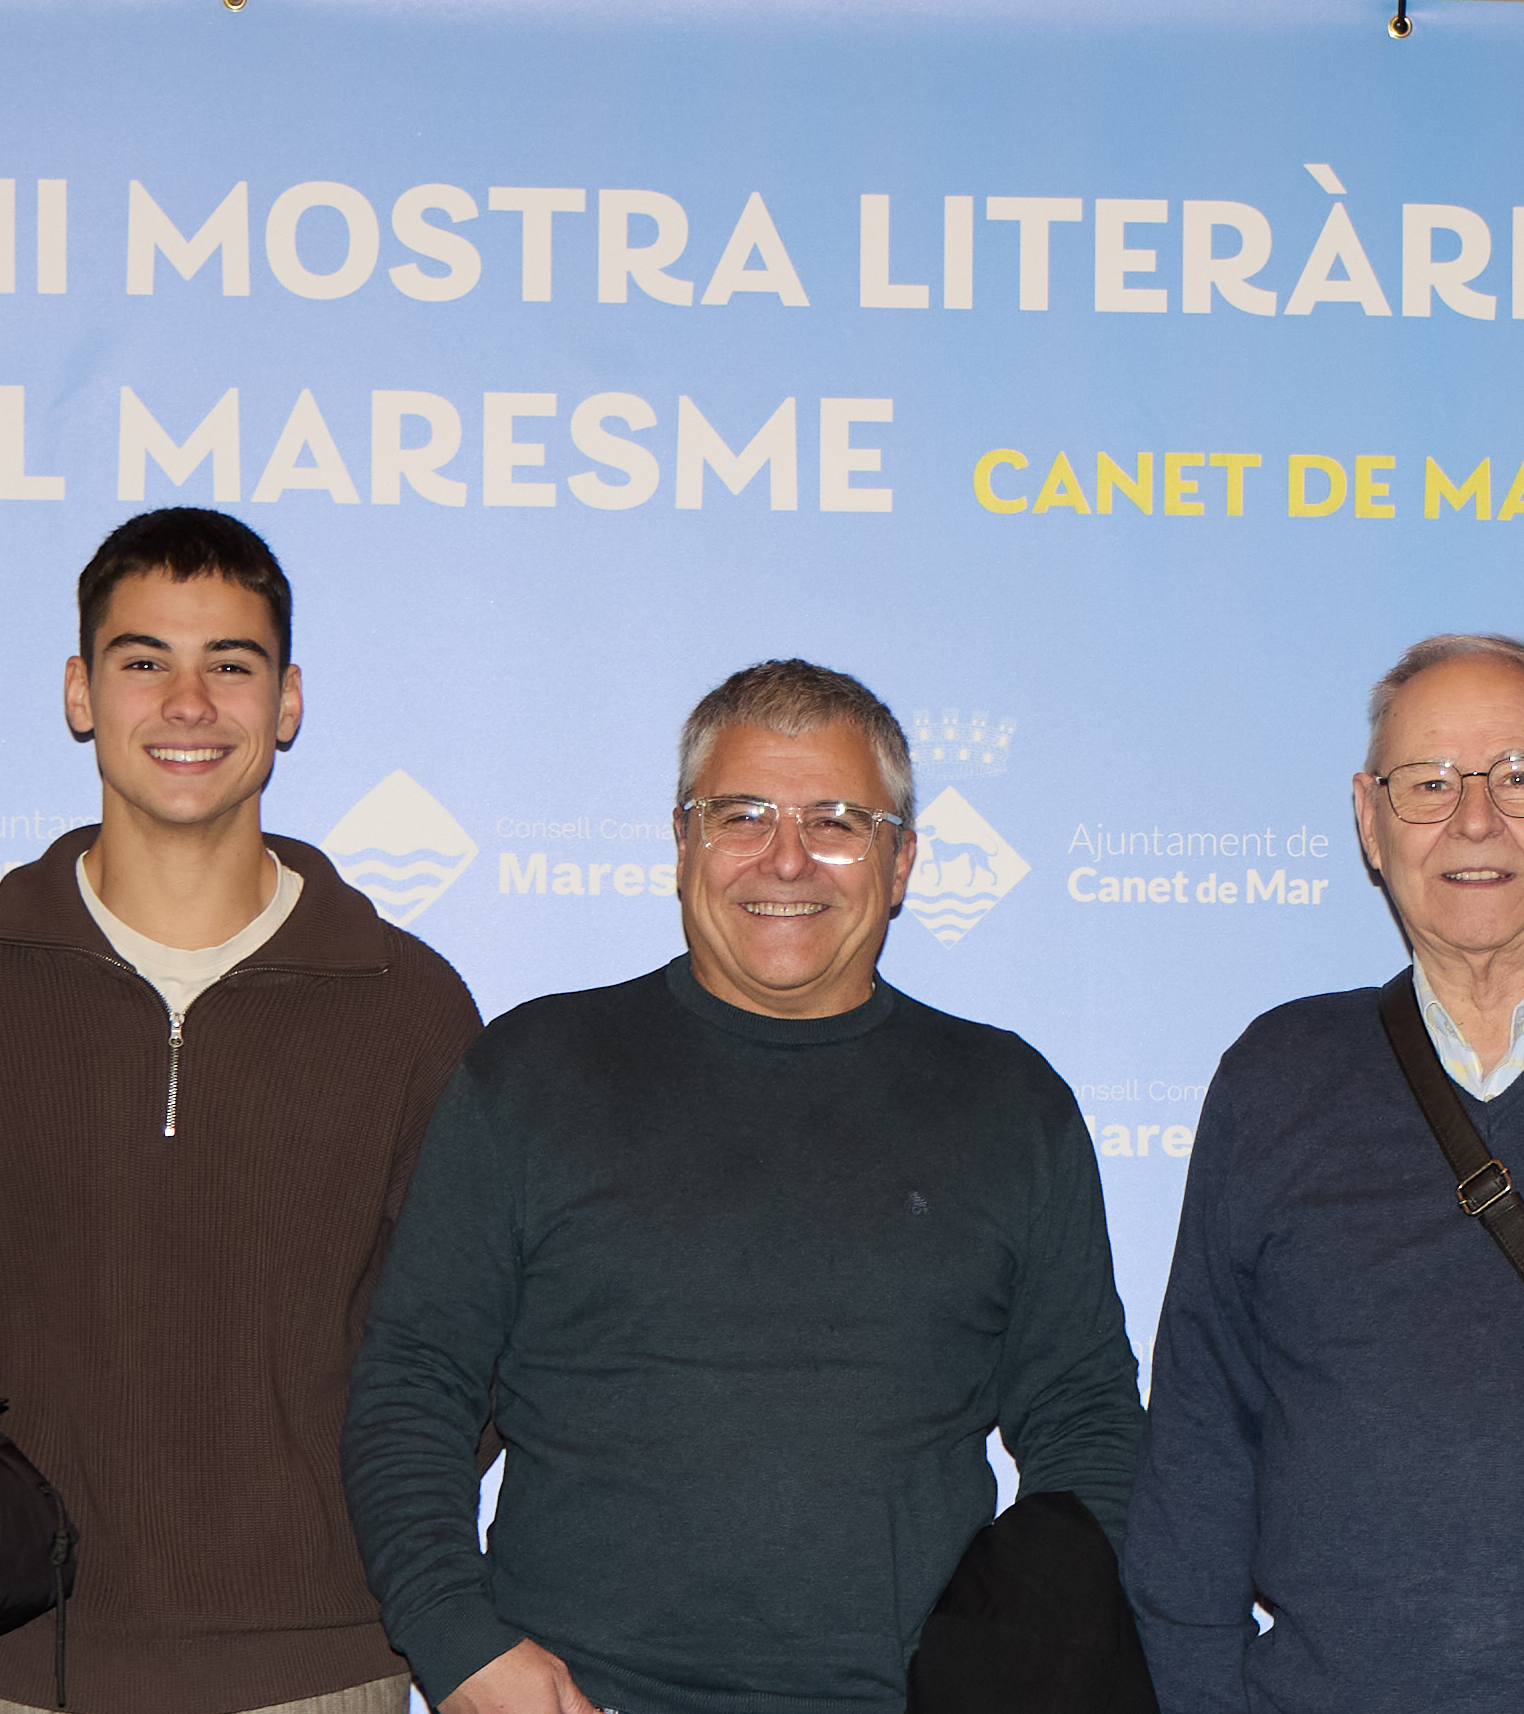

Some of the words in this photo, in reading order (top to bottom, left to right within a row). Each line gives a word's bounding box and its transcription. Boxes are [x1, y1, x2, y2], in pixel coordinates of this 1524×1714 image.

[125, 179, 811, 307] MOSTRA
[117, 385, 894, 513] MARESME
[973, 448, 1262, 517] CANET
[1288, 454, 1396, 519] DE
[495, 816, 592, 839] Consell
[599, 818, 674, 842] Coma
[1067, 822, 1276, 859] Ajuntament
[1286, 825, 1330, 858] de
[497, 852, 677, 898] Mares
[1067, 866, 1189, 904] Canet
[1195, 872, 1239, 904] de
[1246, 868, 1329, 905] Mar
